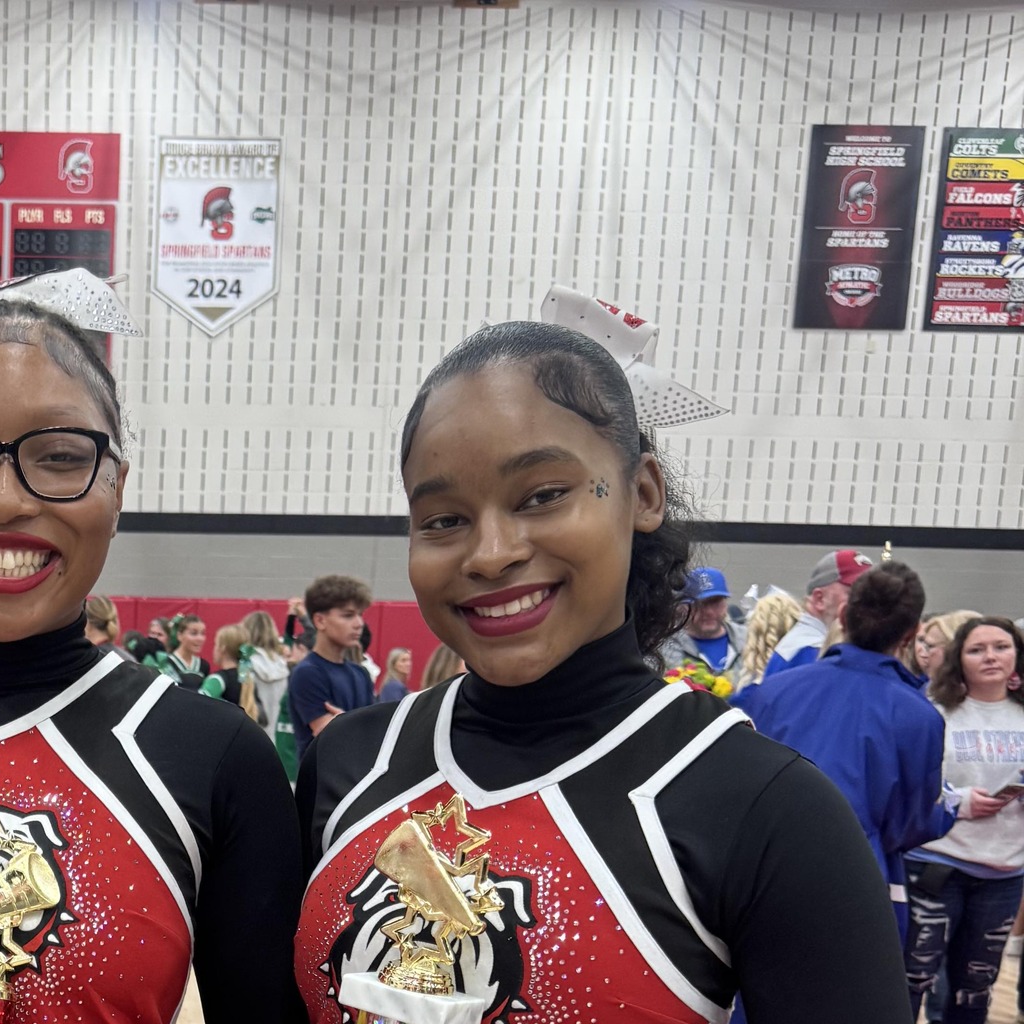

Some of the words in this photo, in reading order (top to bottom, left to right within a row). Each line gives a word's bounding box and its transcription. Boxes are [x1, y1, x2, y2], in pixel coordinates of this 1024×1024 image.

[828, 146, 906, 156] SPRINGFIELD
[953, 144, 998, 155] COLTS
[163, 156, 277, 179] EXCELLENCE
[857, 156, 906, 167] SCHOOL
[951, 169, 1009, 179] COMETS
[947, 192, 1013, 204] FALCONS
[53, 208, 73, 224] FLS
[84, 209, 106, 225] PTS
[945, 217, 1019, 228] PANTHERS
[825, 237, 890, 248] SPARTANS
[941, 240, 1001, 252] RAVENS
[161, 244, 221, 259] SPRINGFIELD
[223, 245, 271, 259] SPARTANS
[831, 266, 880, 281] METRO
[939, 264, 1005, 276] ROCKETS
[186, 278, 242, 299] 2024
[937, 288, 1010, 300] BULLDOGS
[934, 311, 1010, 323] SPARTANS
